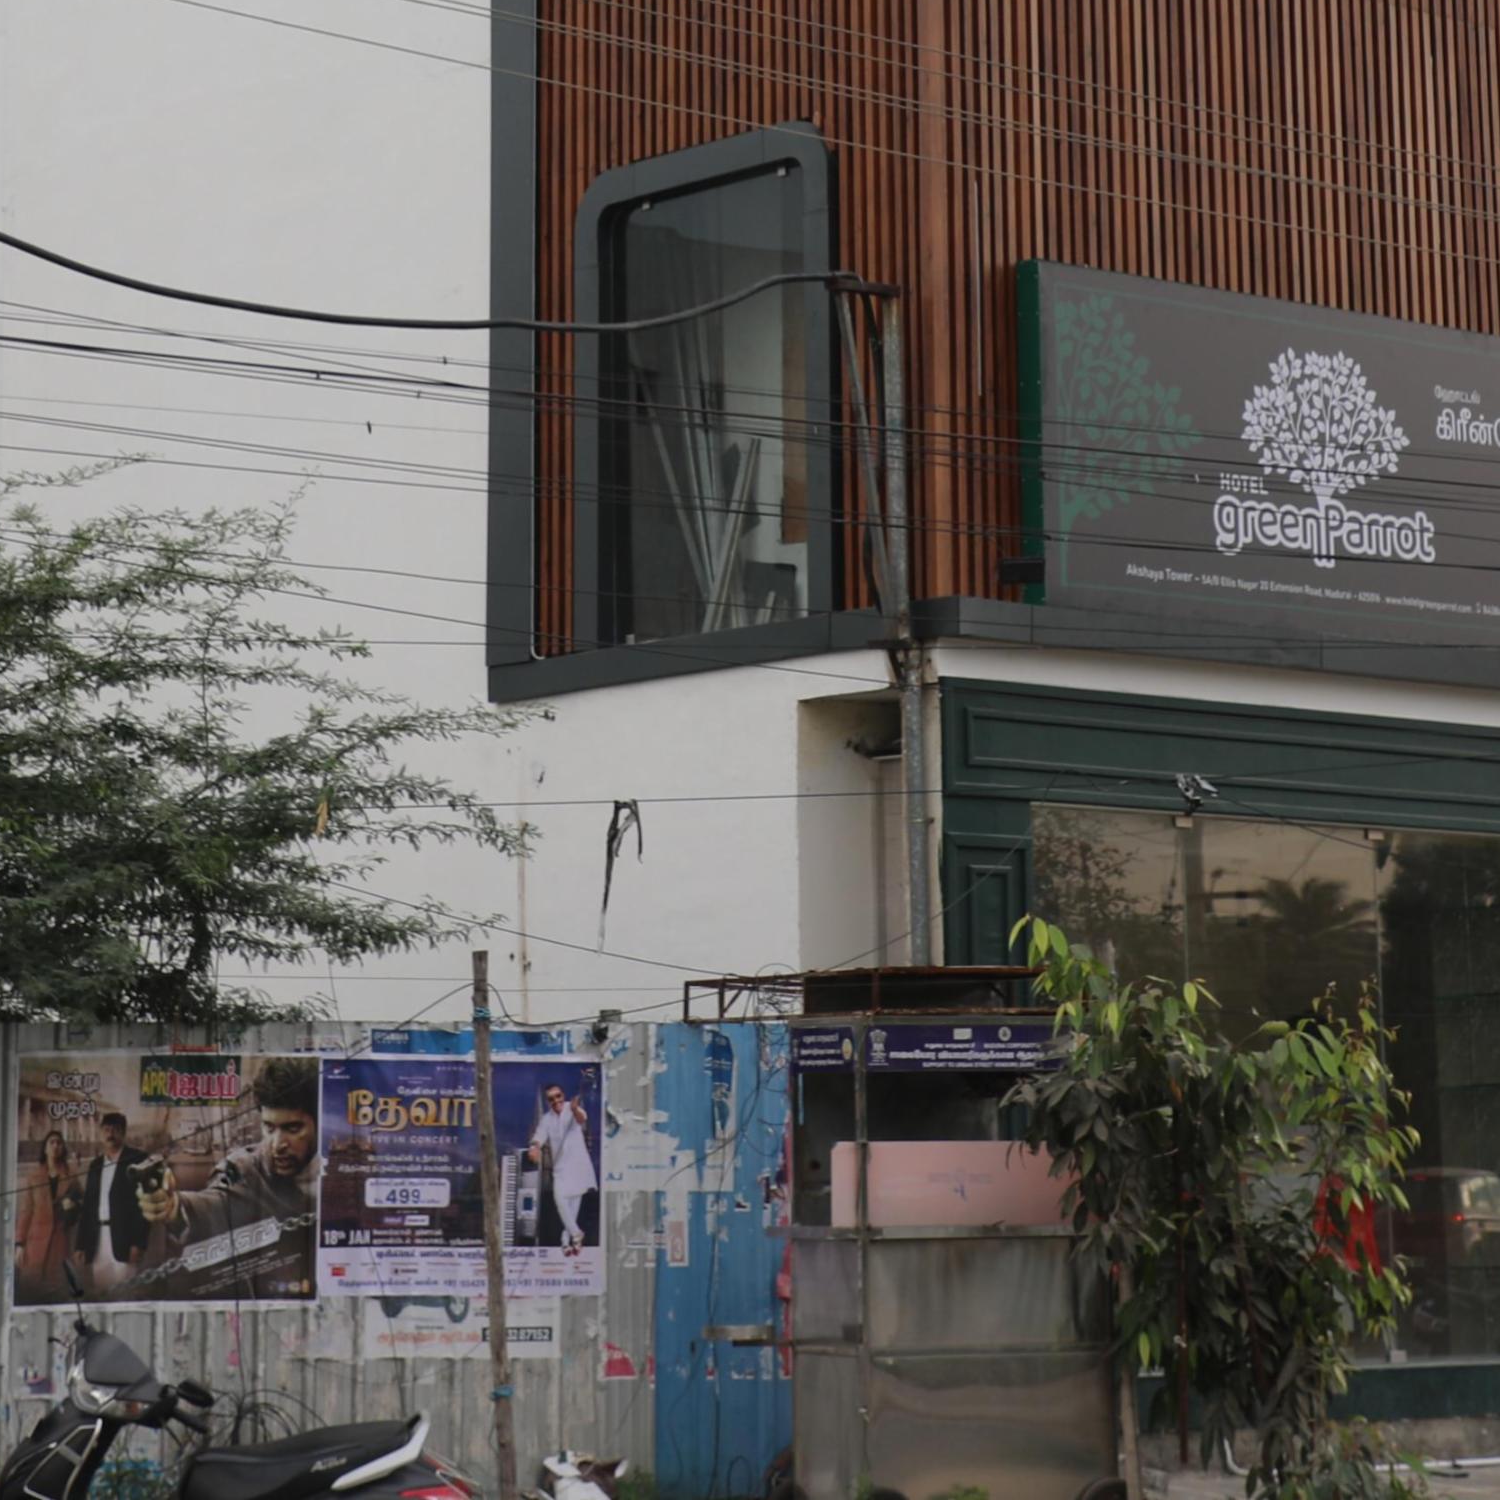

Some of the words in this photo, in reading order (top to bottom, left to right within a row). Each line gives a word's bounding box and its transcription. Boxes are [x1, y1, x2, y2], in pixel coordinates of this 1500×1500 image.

[1433, 384, 1482, 405] ஹோட்டல்
[1220, 472, 1269, 495] HOTEL
[1213, 494, 1436, 568] greenParrot
[1126, 563, 1164, 583] Akshaya
[1166, 568, 1194, 582] Tower
[347, 1088, 477, 1133] தேவா
[410, 1134, 459, 1145] CONCERT
[385, 1189, 421, 1205] 499
[348, 1229, 371, 1246] JAN
